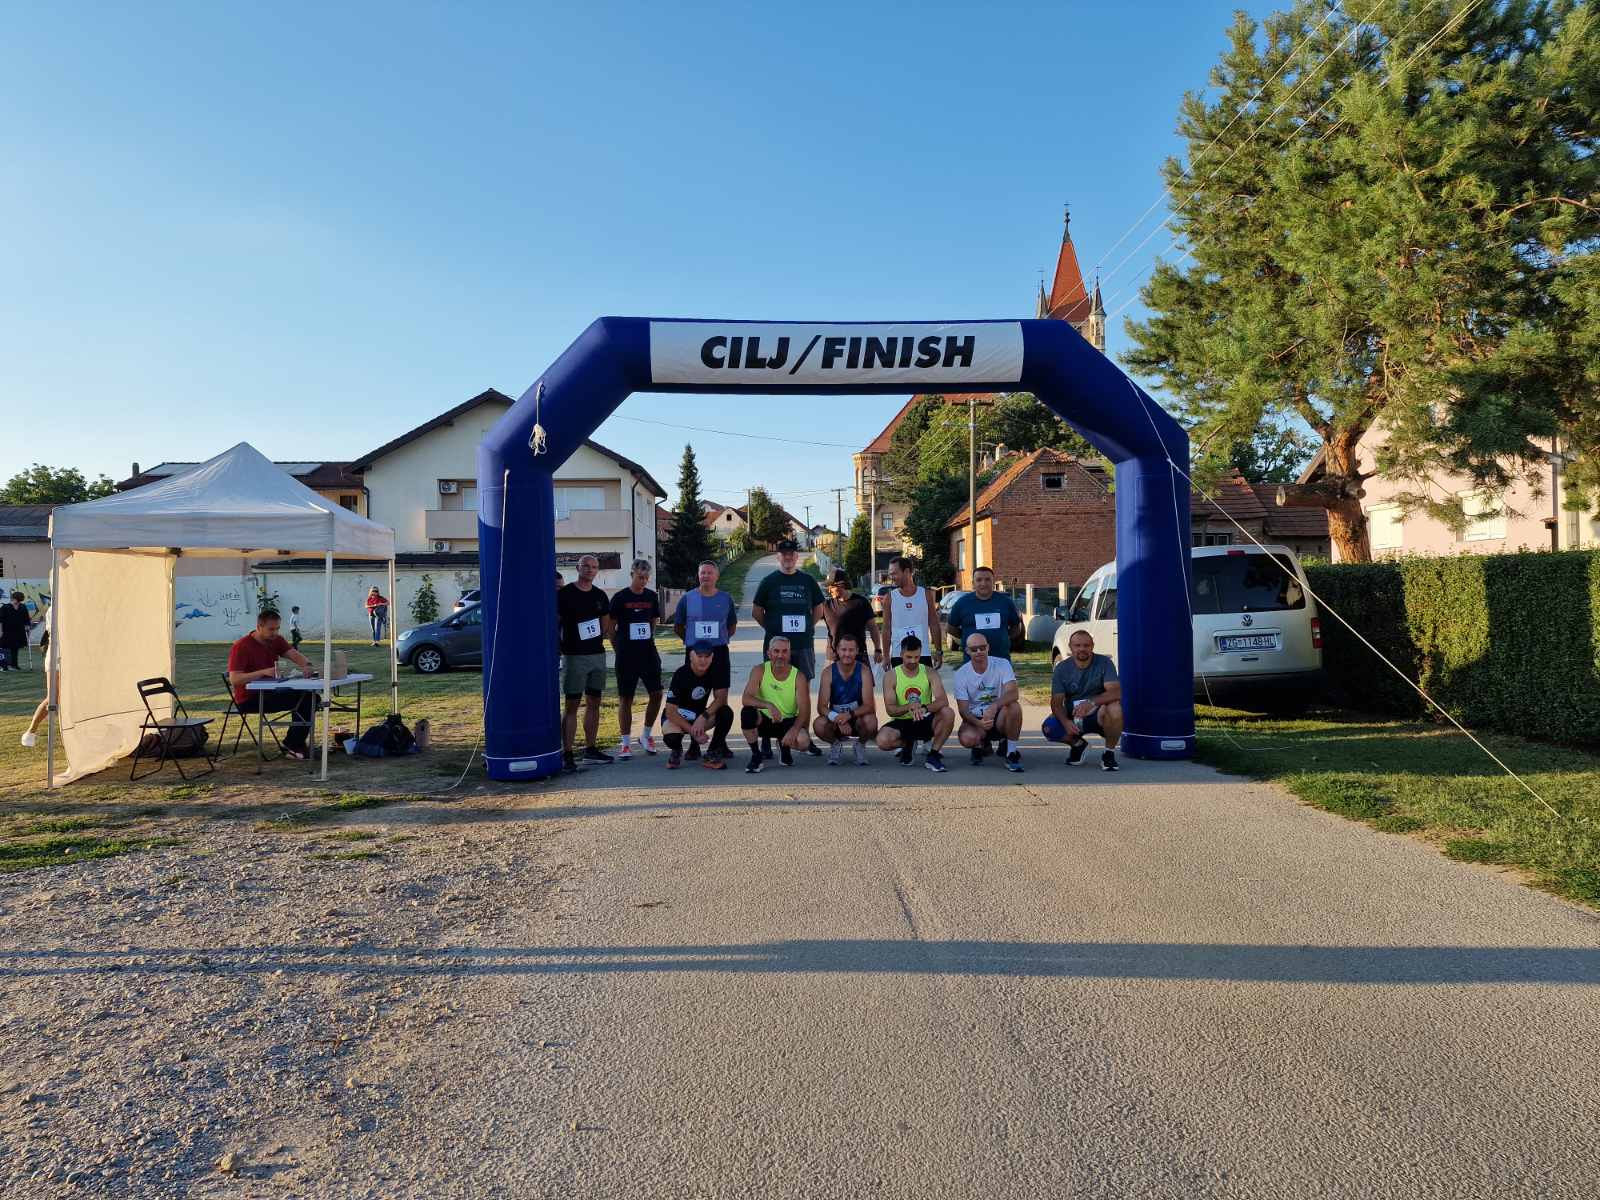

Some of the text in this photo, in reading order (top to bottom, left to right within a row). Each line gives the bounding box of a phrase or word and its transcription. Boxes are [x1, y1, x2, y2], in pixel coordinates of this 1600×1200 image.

[790, 619, 799, 627] 16
[587, 624, 596, 634] 15
[637, 627, 646, 635] 19
